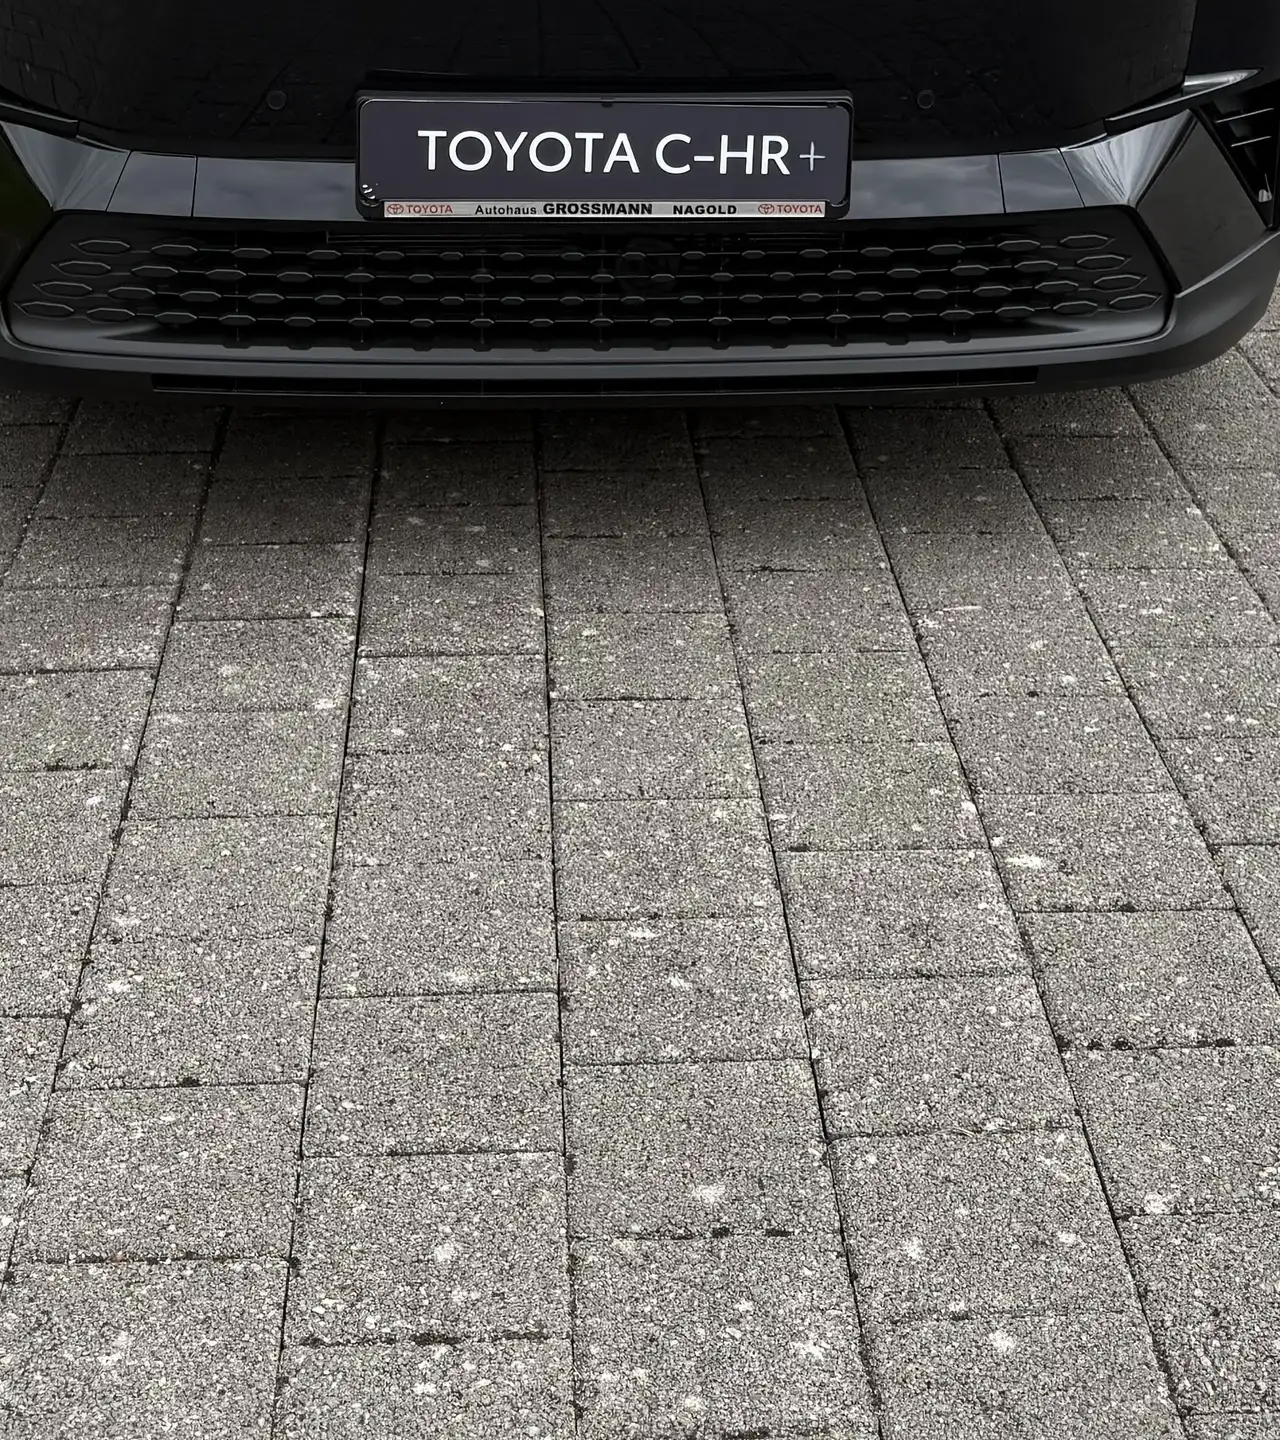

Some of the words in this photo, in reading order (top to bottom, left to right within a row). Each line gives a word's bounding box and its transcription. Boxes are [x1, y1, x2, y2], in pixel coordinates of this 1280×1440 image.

[417, 130, 640, 174] TOYOTA
[406, 204, 454, 214] TOYOTA
[475, 204, 537, 215] Autohaus
[543, 203, 653, 216] GROSSMANN
[673, 205, 737, 215] NAGOLD
[777, 204, 823, 214] TOYOTA
